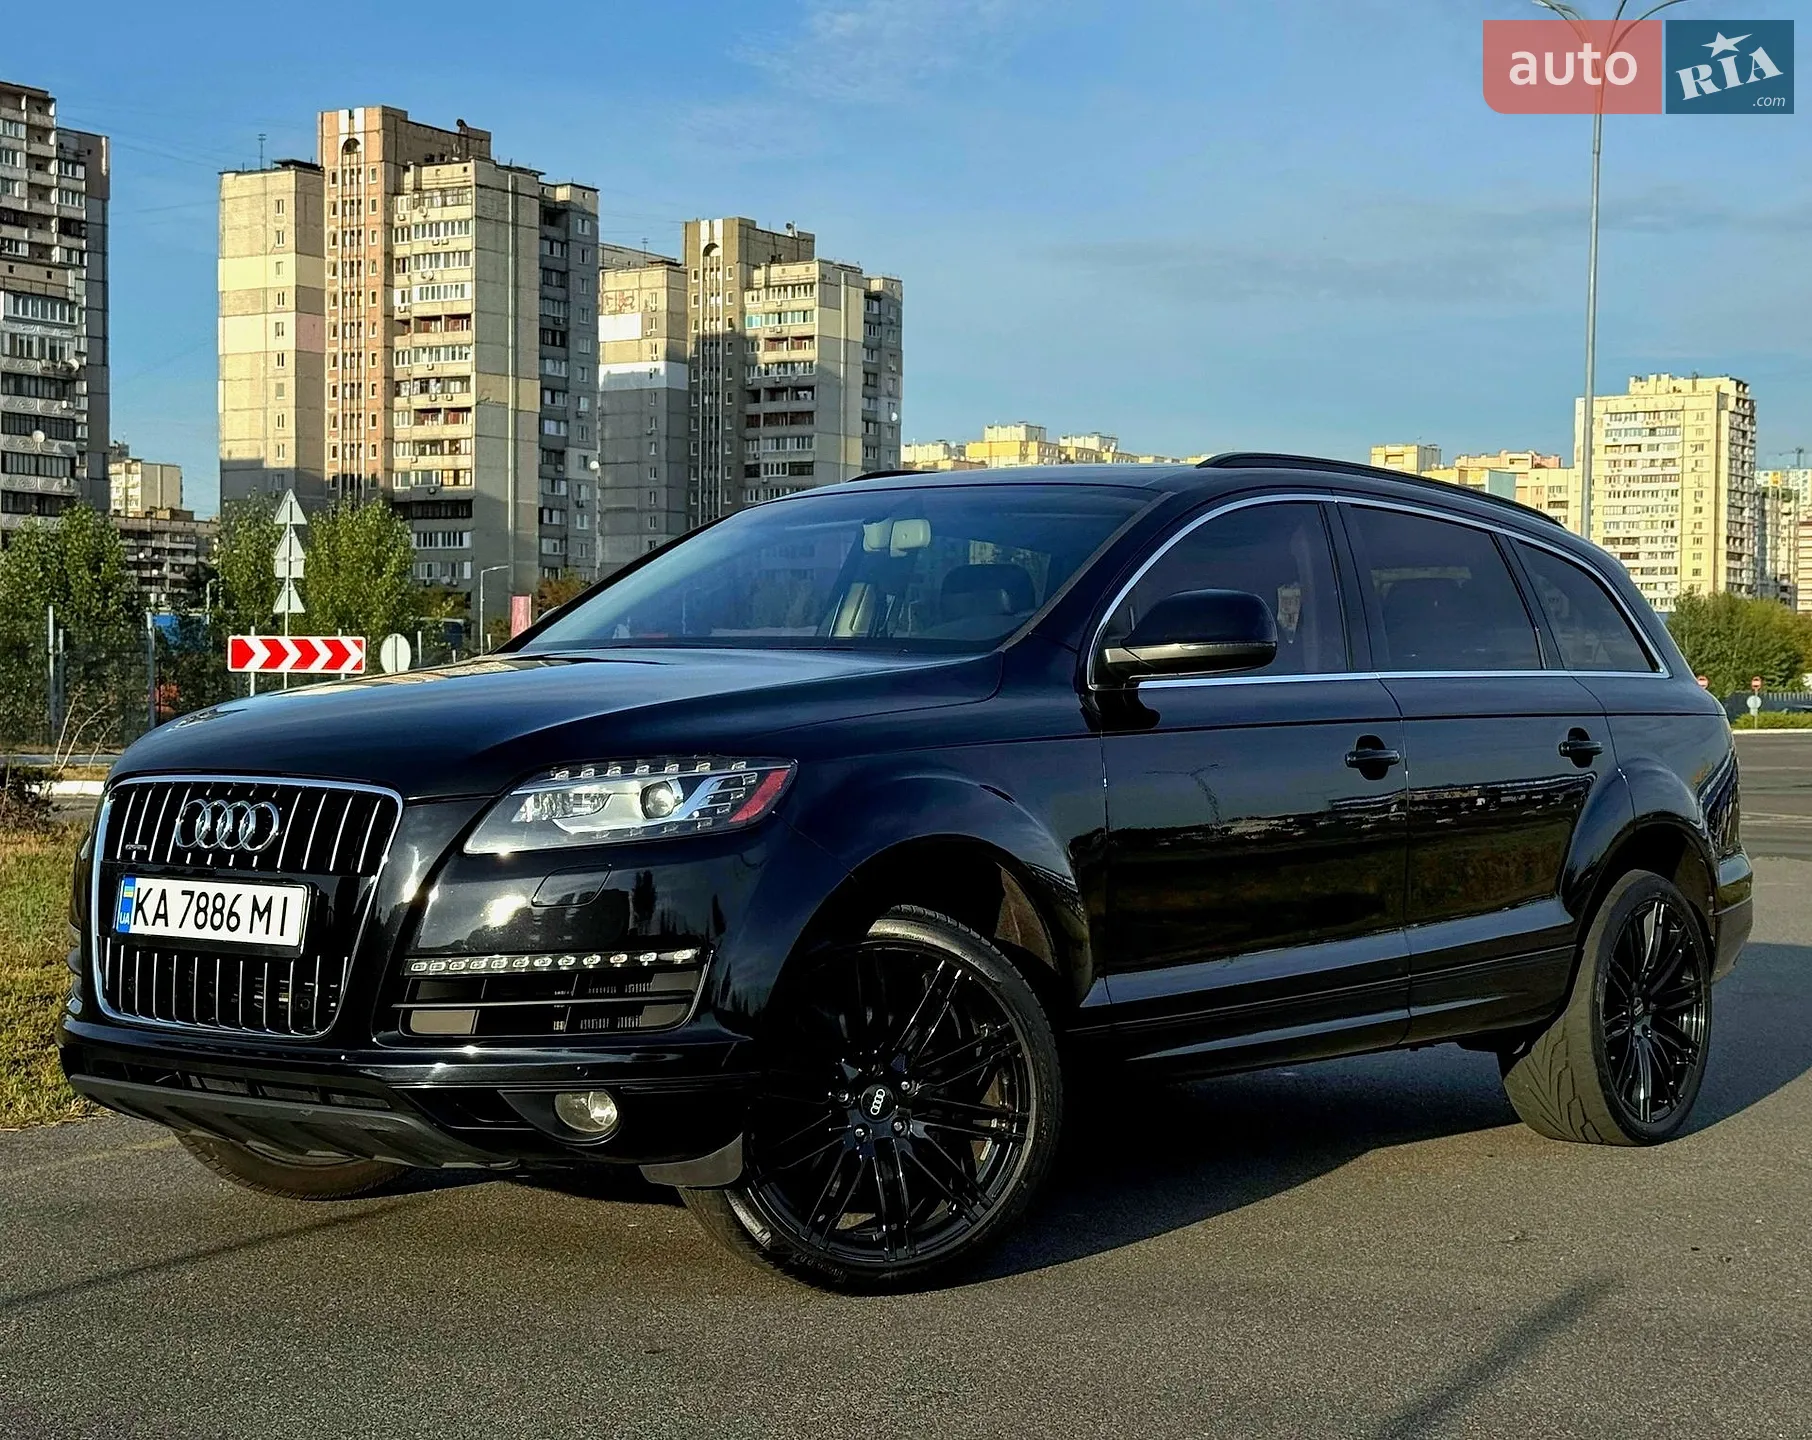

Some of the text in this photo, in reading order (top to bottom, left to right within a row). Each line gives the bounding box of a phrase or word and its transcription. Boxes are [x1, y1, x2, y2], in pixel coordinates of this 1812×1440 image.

[119, 911, 130, 926] UA
[133, 887, 288, 937] KA 7886 MI
